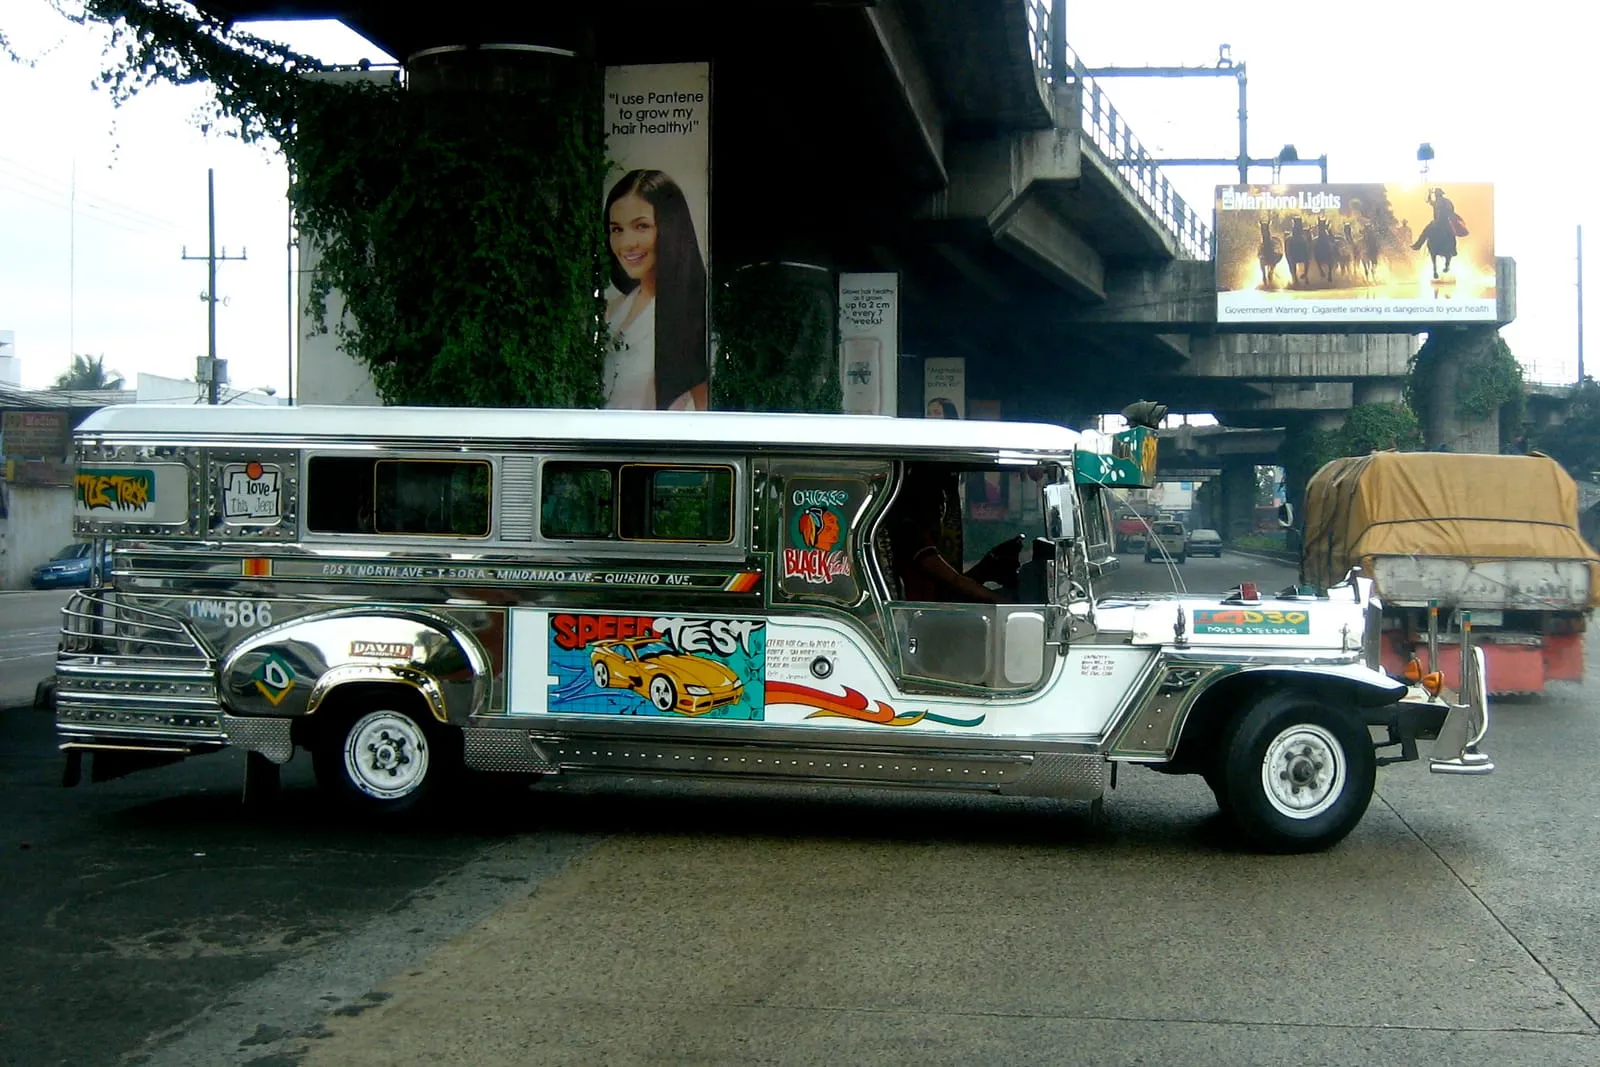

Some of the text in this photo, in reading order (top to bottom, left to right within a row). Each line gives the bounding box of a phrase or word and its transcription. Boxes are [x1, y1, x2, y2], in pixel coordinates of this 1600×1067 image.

[622, 94, 644, 104] use
[648, 92, 704, 104] Pantene
[619, 107, 693, 121] to grow my
[612, 122, 637, 135] hair
[1235, 190, 1297, 210] Marlboro
[1299, 190, 1341, 213] Lights
[845, 302, 857, 310] up
[1224, 306, 1273, 314] Government
[1311, 305, 1348, 315] Cigarette
[1350, 305, 1383, 315] smoking
[1384, 304, 1391, 313] is
[1392, 305, 1434, 315] dangerous
[1436, 305, 1444, 313] to
[1446, 305, 1462, 315] your
[1465, 304, 1489, 313] health
[852, 310, 876, 320] every
[237, 480, 270, 496] I love
[255, 497, 275, 514] Jeep
[358, 564, 398, 578] NORTH
[401, 566, 424, 577] AVE
[449, 568, 486, 579] SORA
[496, 569, 566, 582] MINDANAO
[604, 573, 660, 585] QUIRINO
[664, 574, 693, 586] AVE.
[553, 614, 768, 659] SPEED TEST
[353, 641, 408, 657] DAVID
